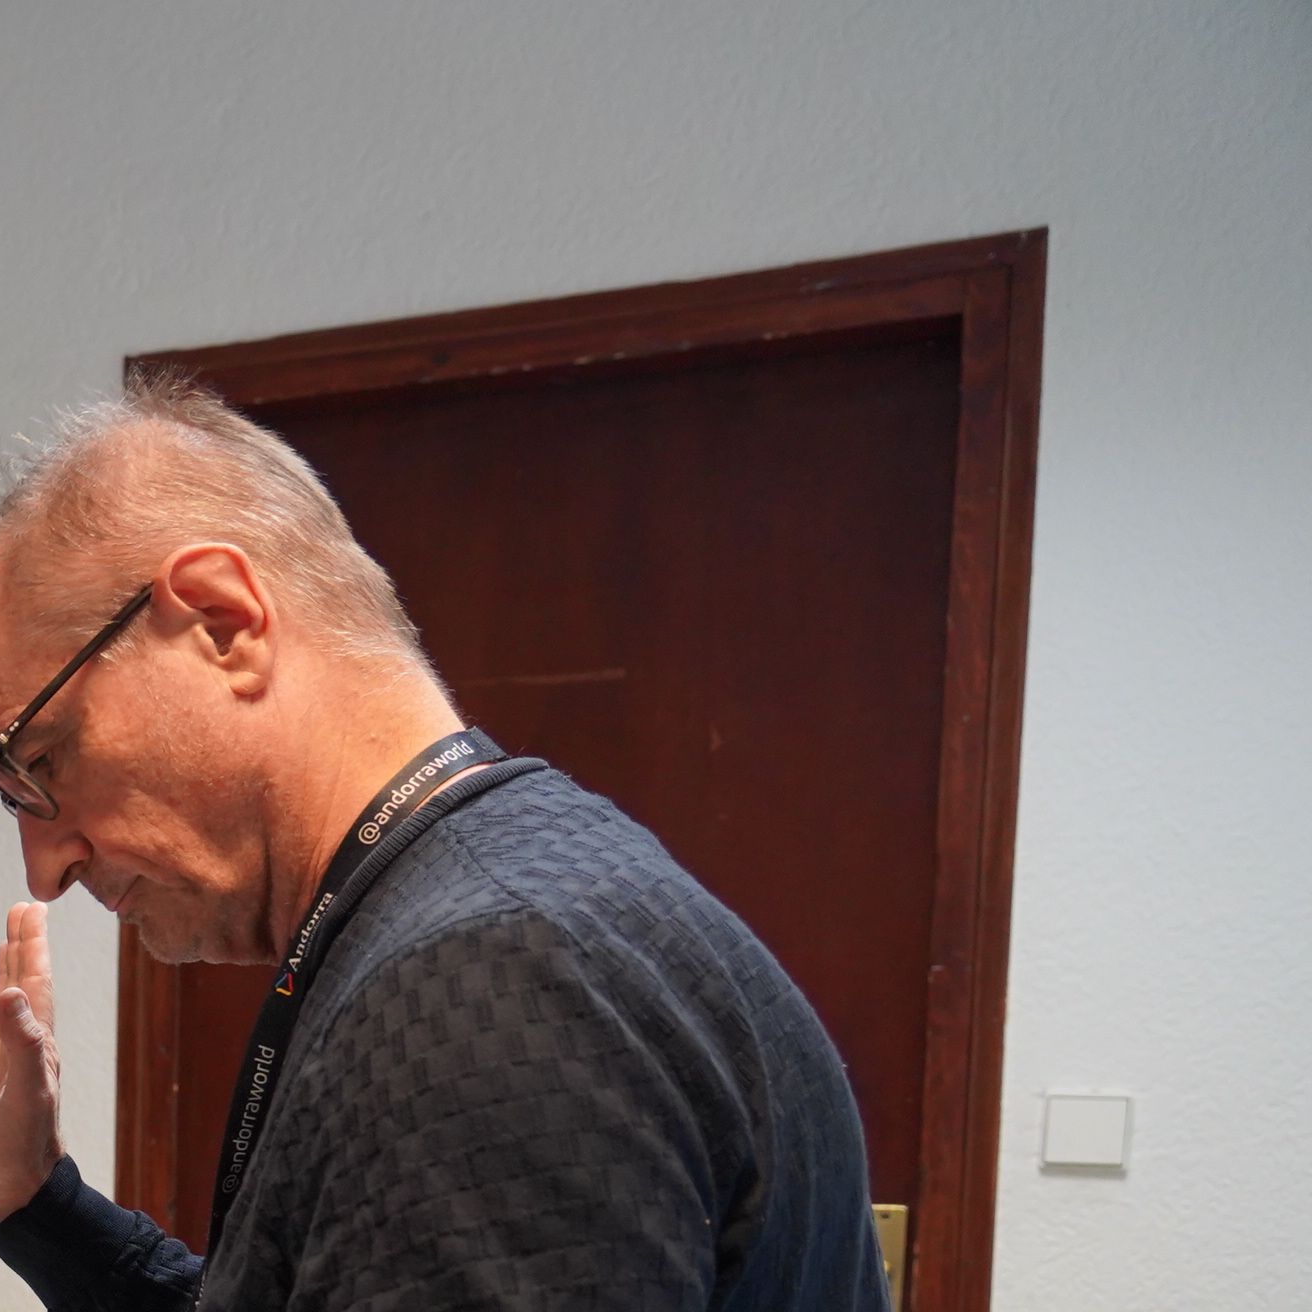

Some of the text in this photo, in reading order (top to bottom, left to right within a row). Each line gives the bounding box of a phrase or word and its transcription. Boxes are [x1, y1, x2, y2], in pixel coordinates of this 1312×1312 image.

[358, 740, 474, 846] @andorraworld
[288, 892, 334, 972] Andorra
[221, 1045, 275, 1194] @andorraworld
